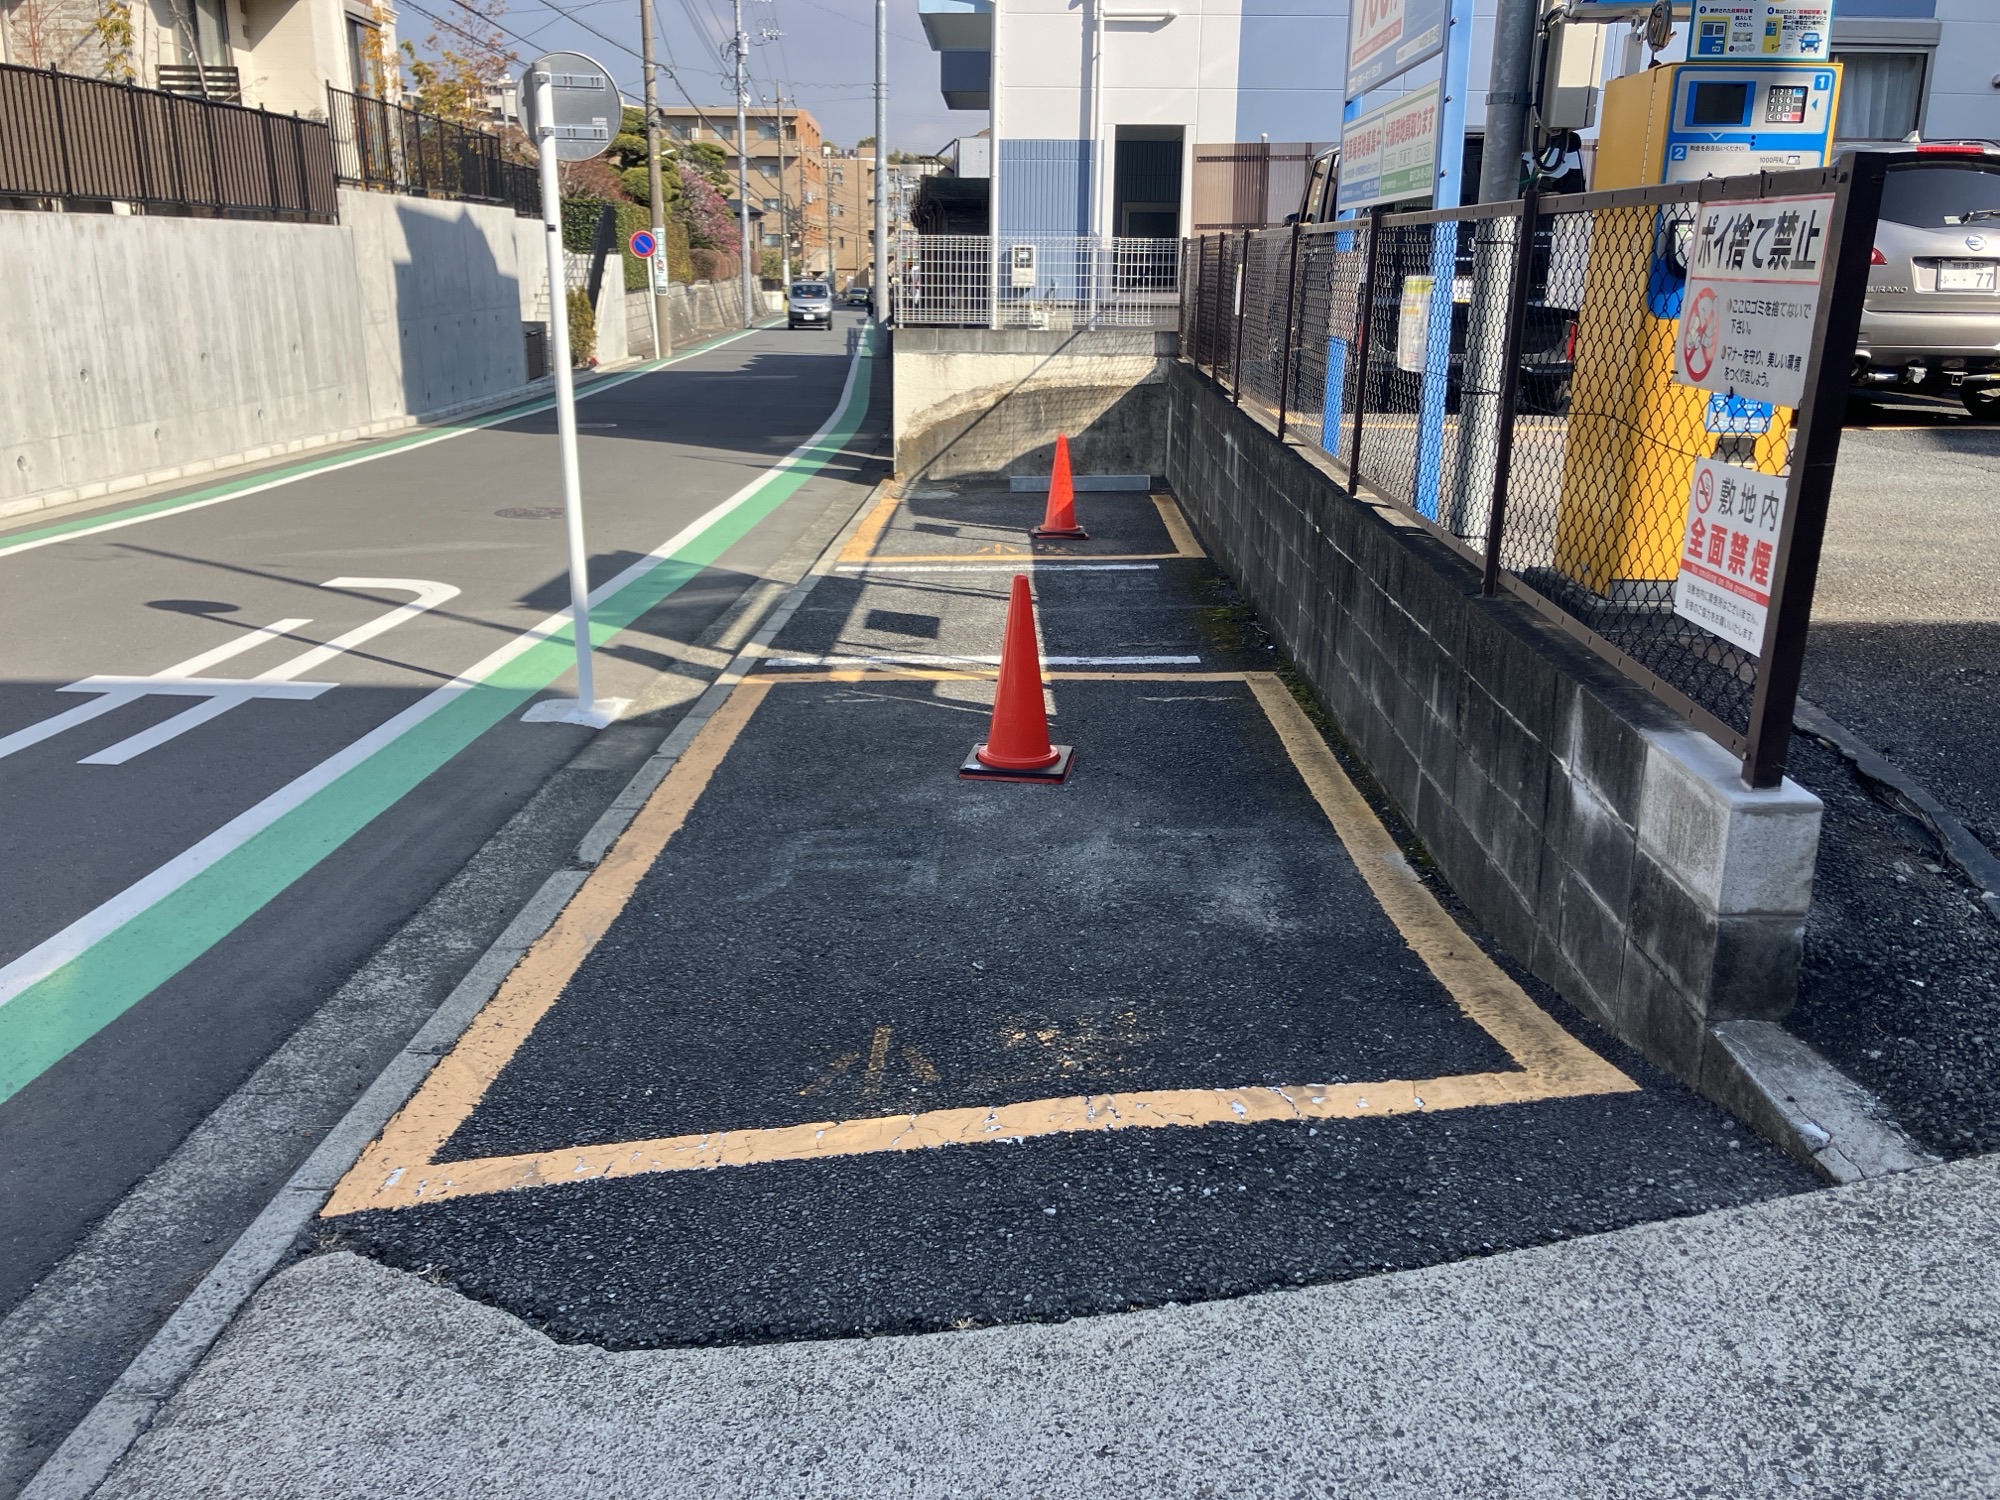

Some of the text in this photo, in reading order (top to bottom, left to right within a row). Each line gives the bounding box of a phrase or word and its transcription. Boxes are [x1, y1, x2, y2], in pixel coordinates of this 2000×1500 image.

[1673, 147, 1683, 159] 2
[1759, 156, 1785, 164] 1000円札
[1697, 209, 1821, 271] ポイ捨て禁止
[1732, 298, 1811, 319] ここにゴミを捨てないで
[1731, 318, 1751, 335] 下さい。
[1724, 366, 1770, 388] をつくりましょう。
[1718, 477, 1779, 532] 敷地内
[1687, 517, 1773, 587] 全面禁煙
[1699, 568, 1718, 585] smoking
[1725, 578, 1734, 591] the
